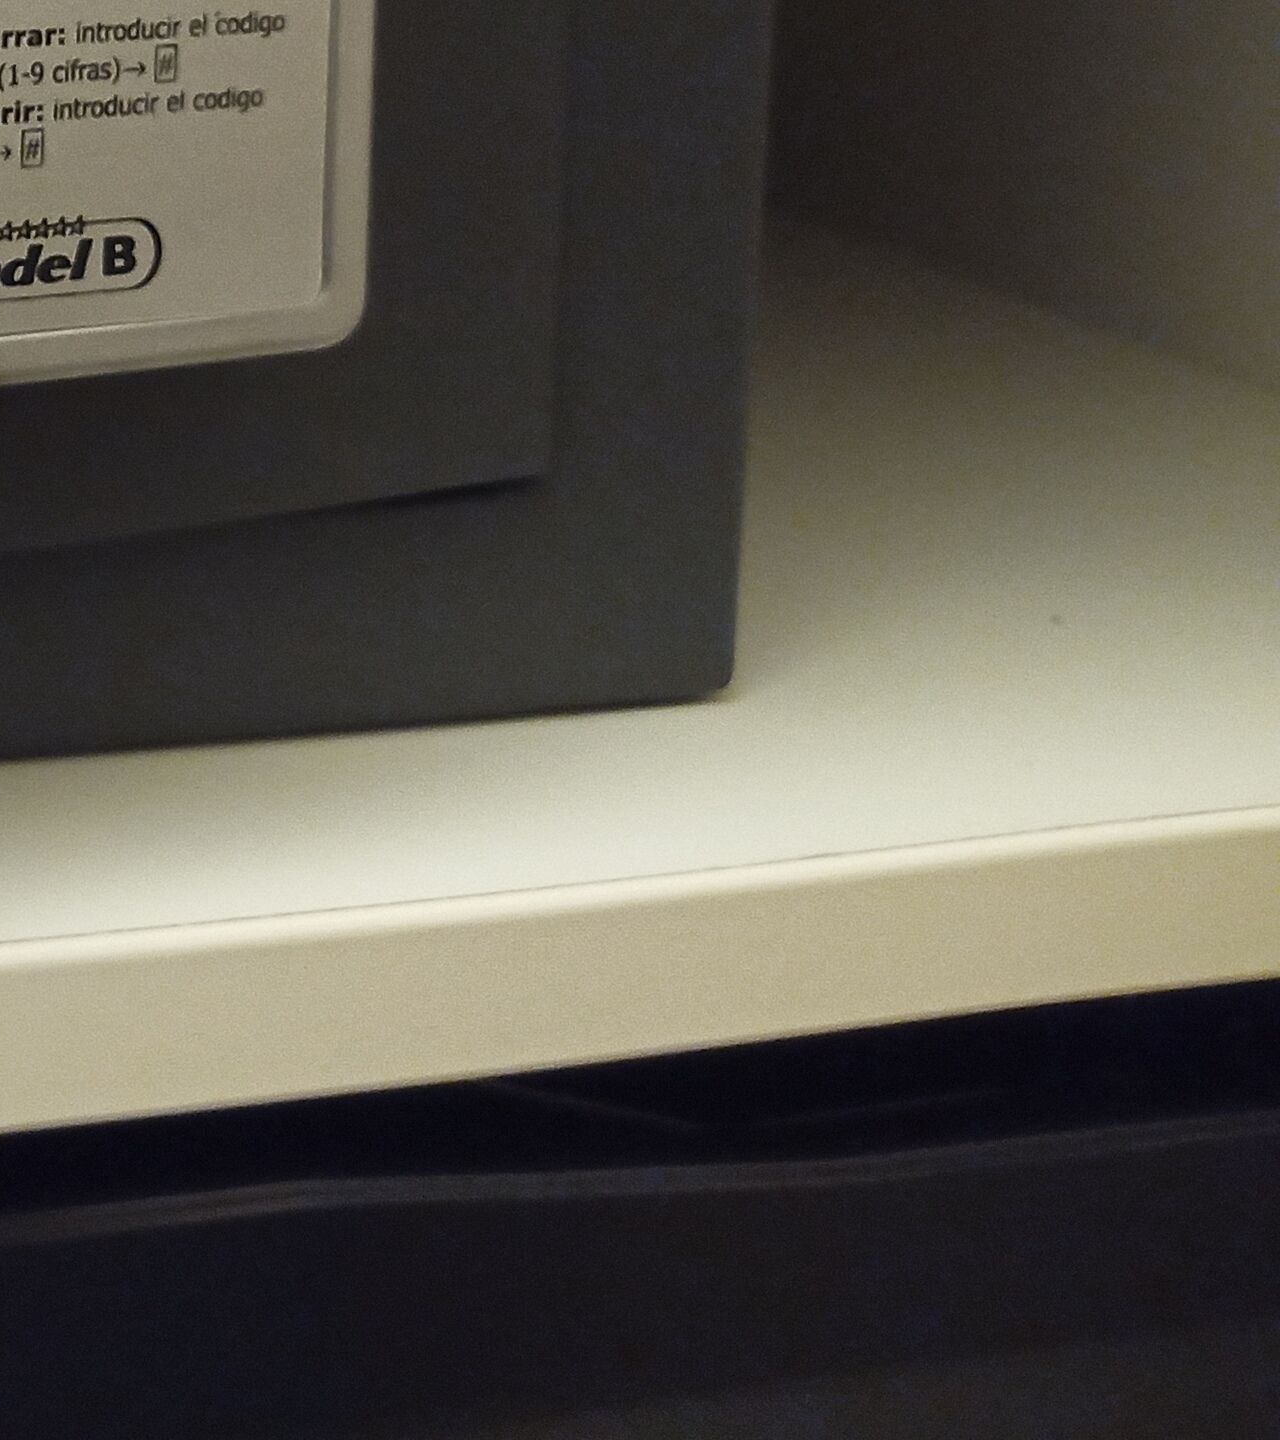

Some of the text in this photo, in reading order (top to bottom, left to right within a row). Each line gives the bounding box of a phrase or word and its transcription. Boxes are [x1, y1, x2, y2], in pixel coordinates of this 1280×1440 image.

[76, 17, 182, 44] introducir
[188, 12, 209, 38] el
[52, 56, 121, 85] cifras)
[53, 93, 160, 122] introducir
[166, 90, 186, 114] el
[101, 236, 137, 275] B
